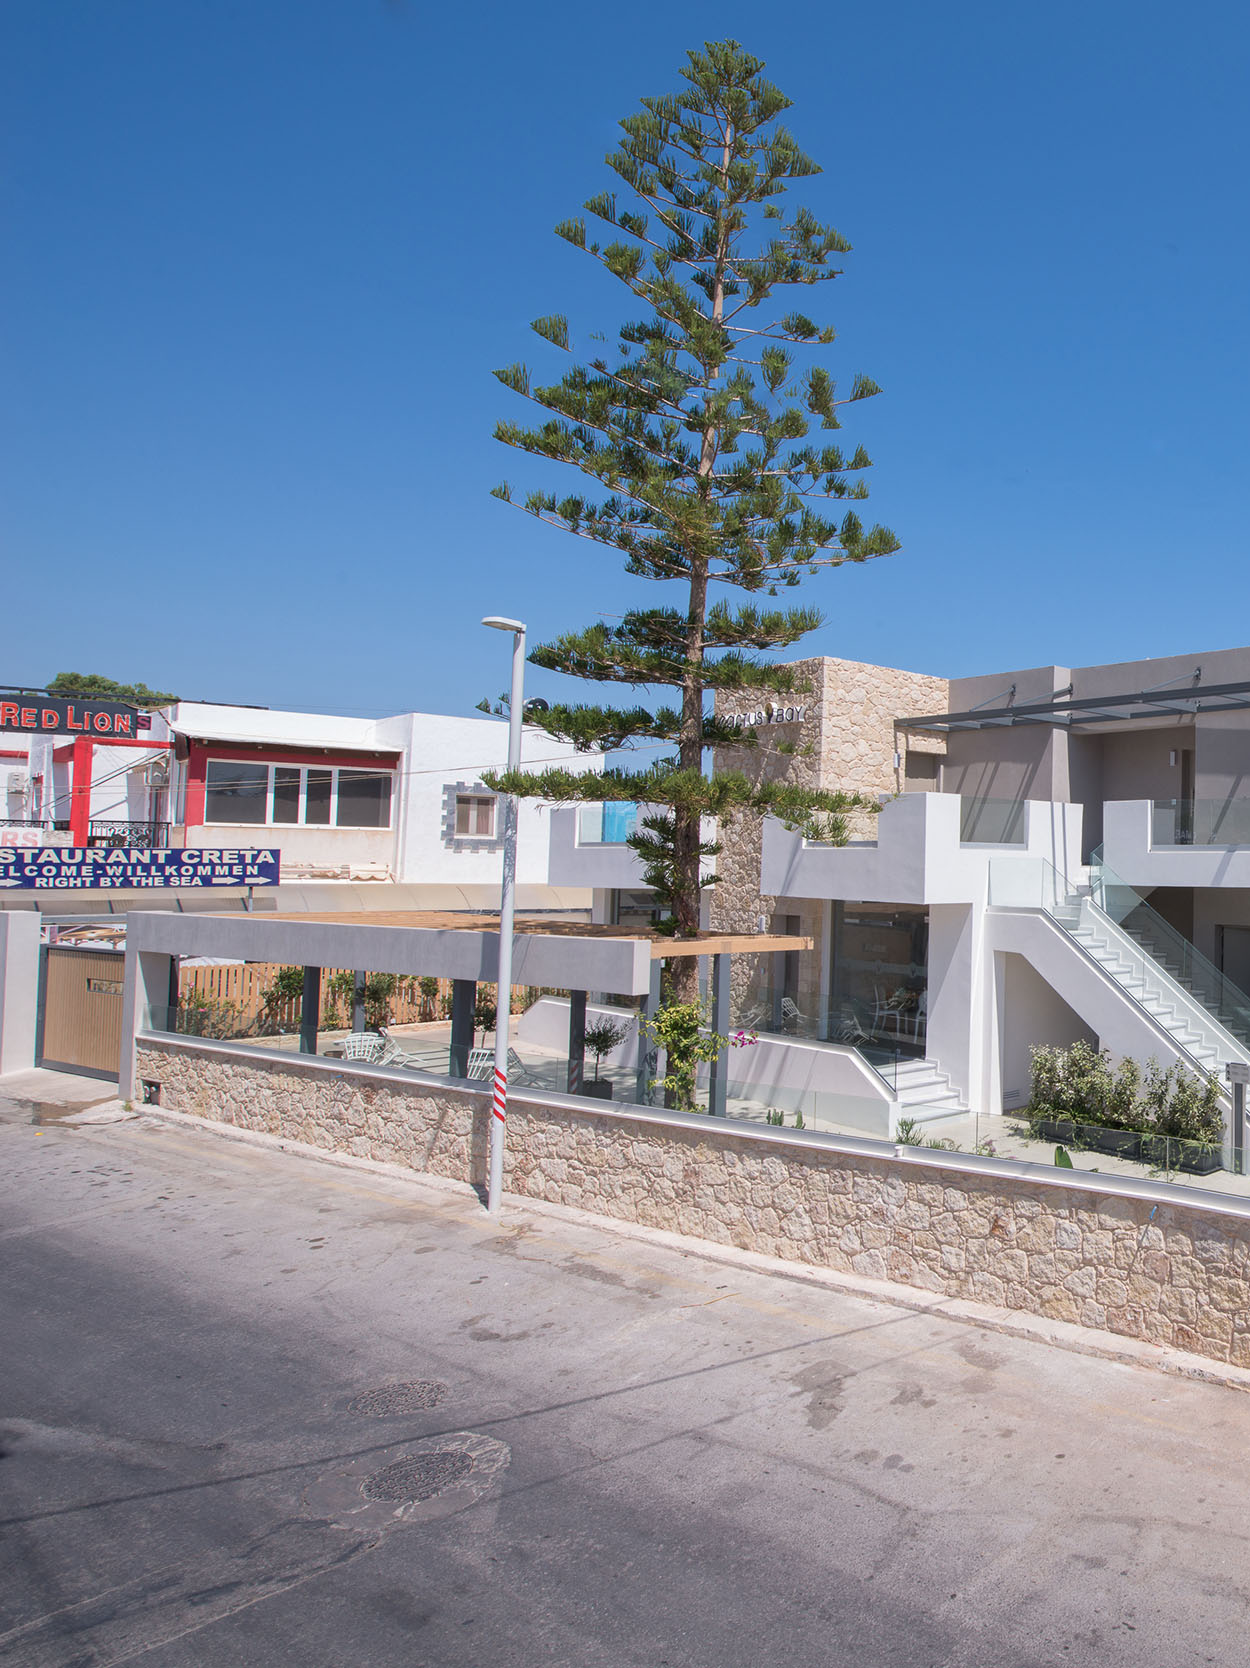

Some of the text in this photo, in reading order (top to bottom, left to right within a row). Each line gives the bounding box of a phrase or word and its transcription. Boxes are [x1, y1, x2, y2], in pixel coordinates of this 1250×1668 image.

[0, 701, 132, 733] RED LION
[181, 849, 275, 864] CRETA
[35, 876, 203, 888] RIGHT BY THE SEA
